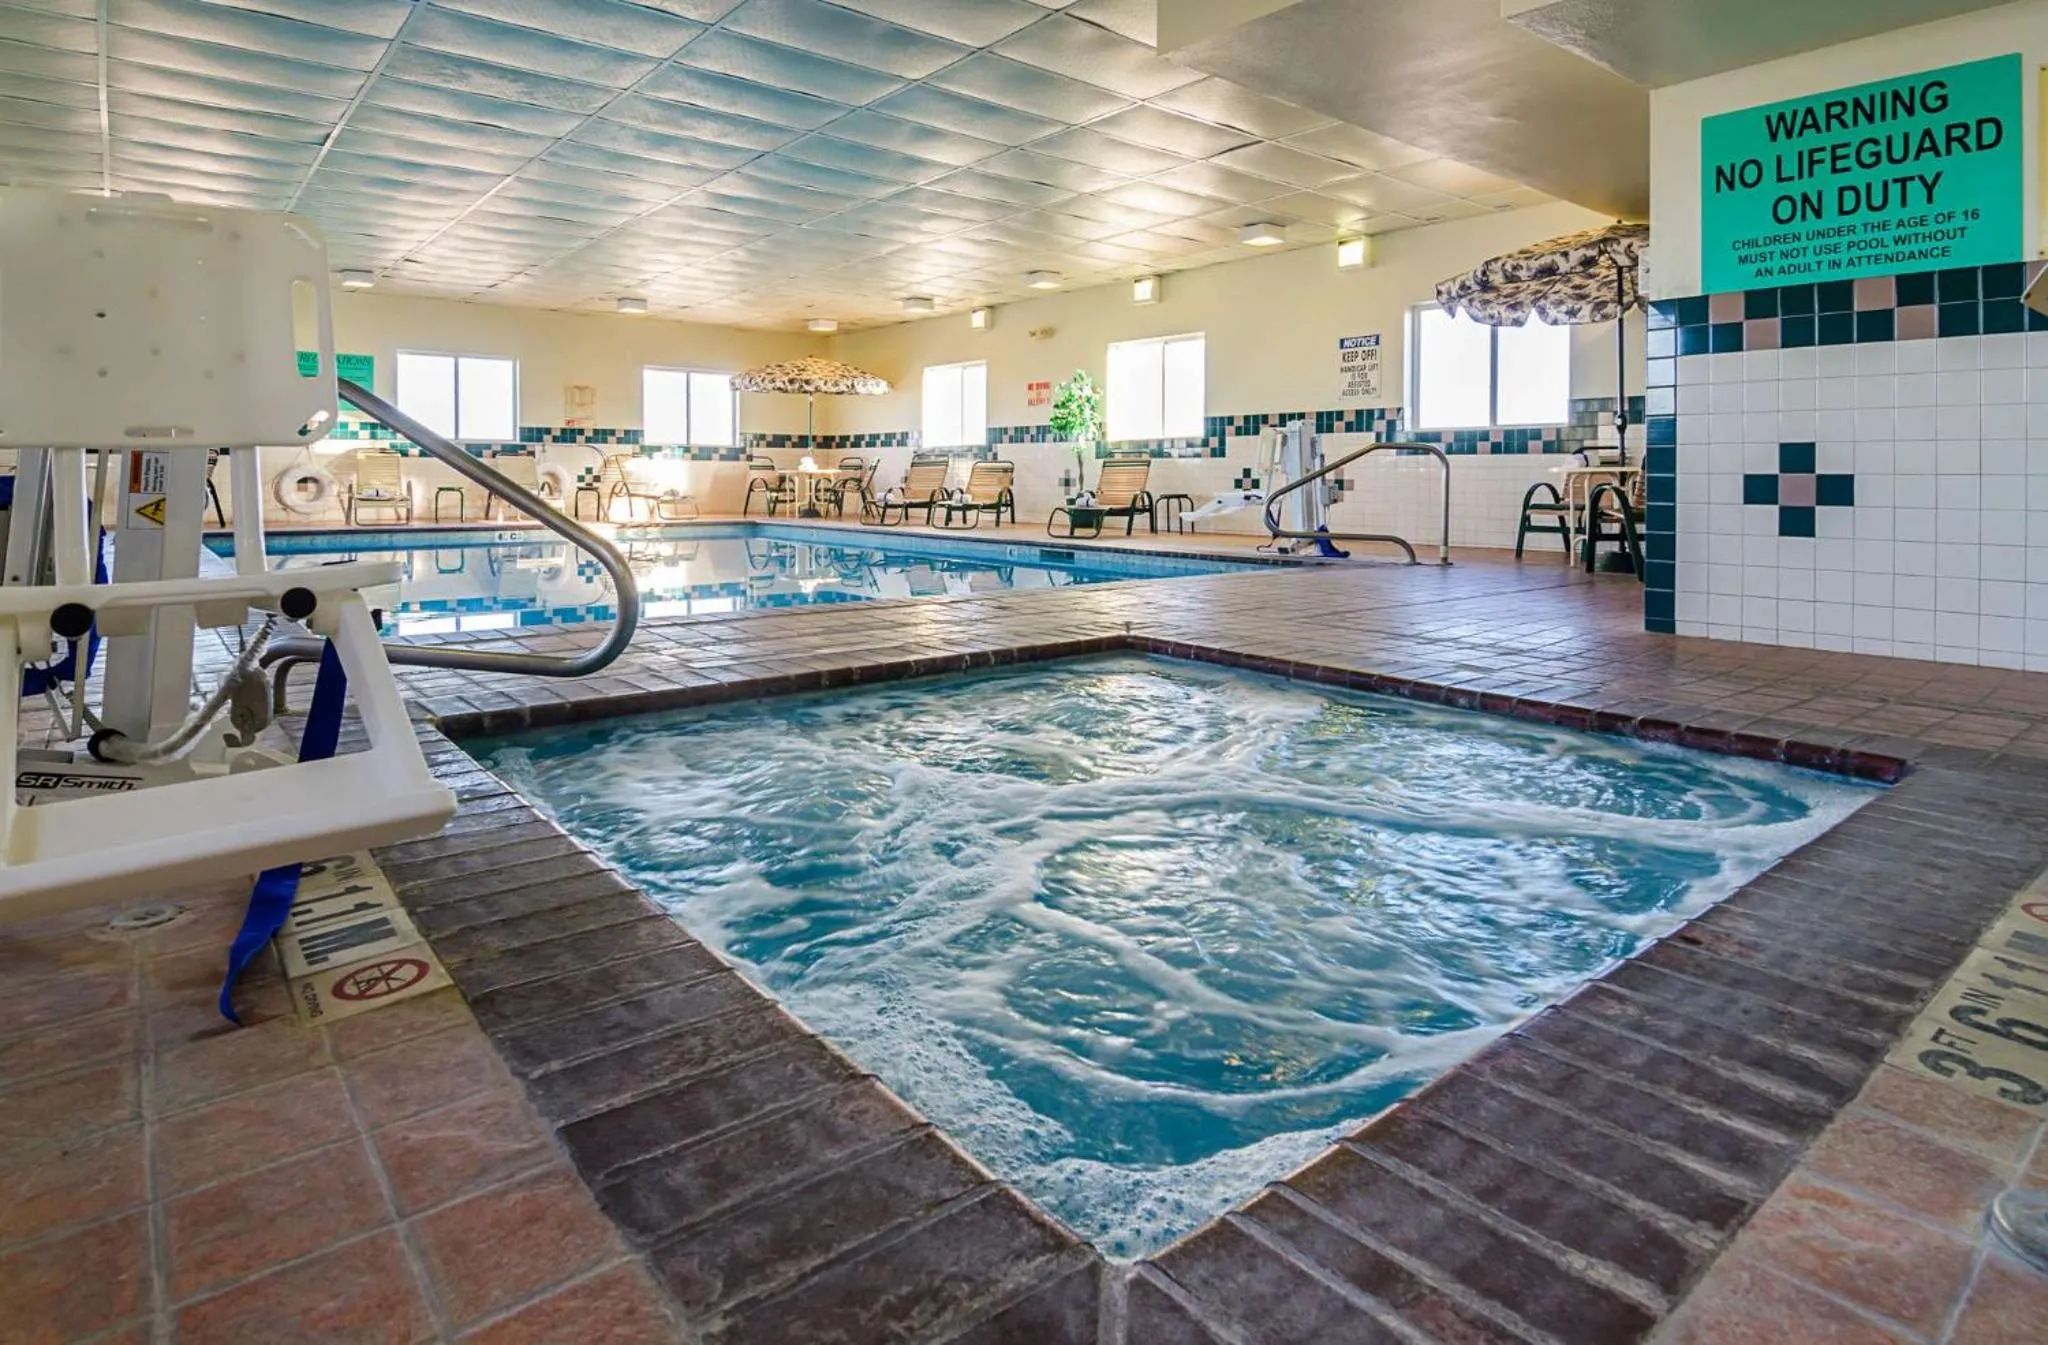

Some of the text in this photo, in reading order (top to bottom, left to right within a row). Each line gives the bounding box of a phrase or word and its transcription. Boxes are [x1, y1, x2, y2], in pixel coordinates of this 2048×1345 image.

[1765, 80, 1950, 143] WARNING
[1715, 116, 2004, 193] NO LIFEGUARD
[1772, 171, 1944, 225] ON DUTY
[1732, 208, 1981, 252] CHILDREN UNDER THE AGE OF 16
[1737, 225, 1969, 266] MUST NOT USE POOL WITHOUT
[1754, 245, 1952, 279] AN ADULT IN ATTENDANCE
[1342, 348, 1377, 363] KEEP OFF!
[1343, 335, 1377, 348] NOTICE
[18, 774, 136, 791] SR Smith
[1929, 1027, 1978, 1055] FT
[1960, 987, 2006, 1010] IN
